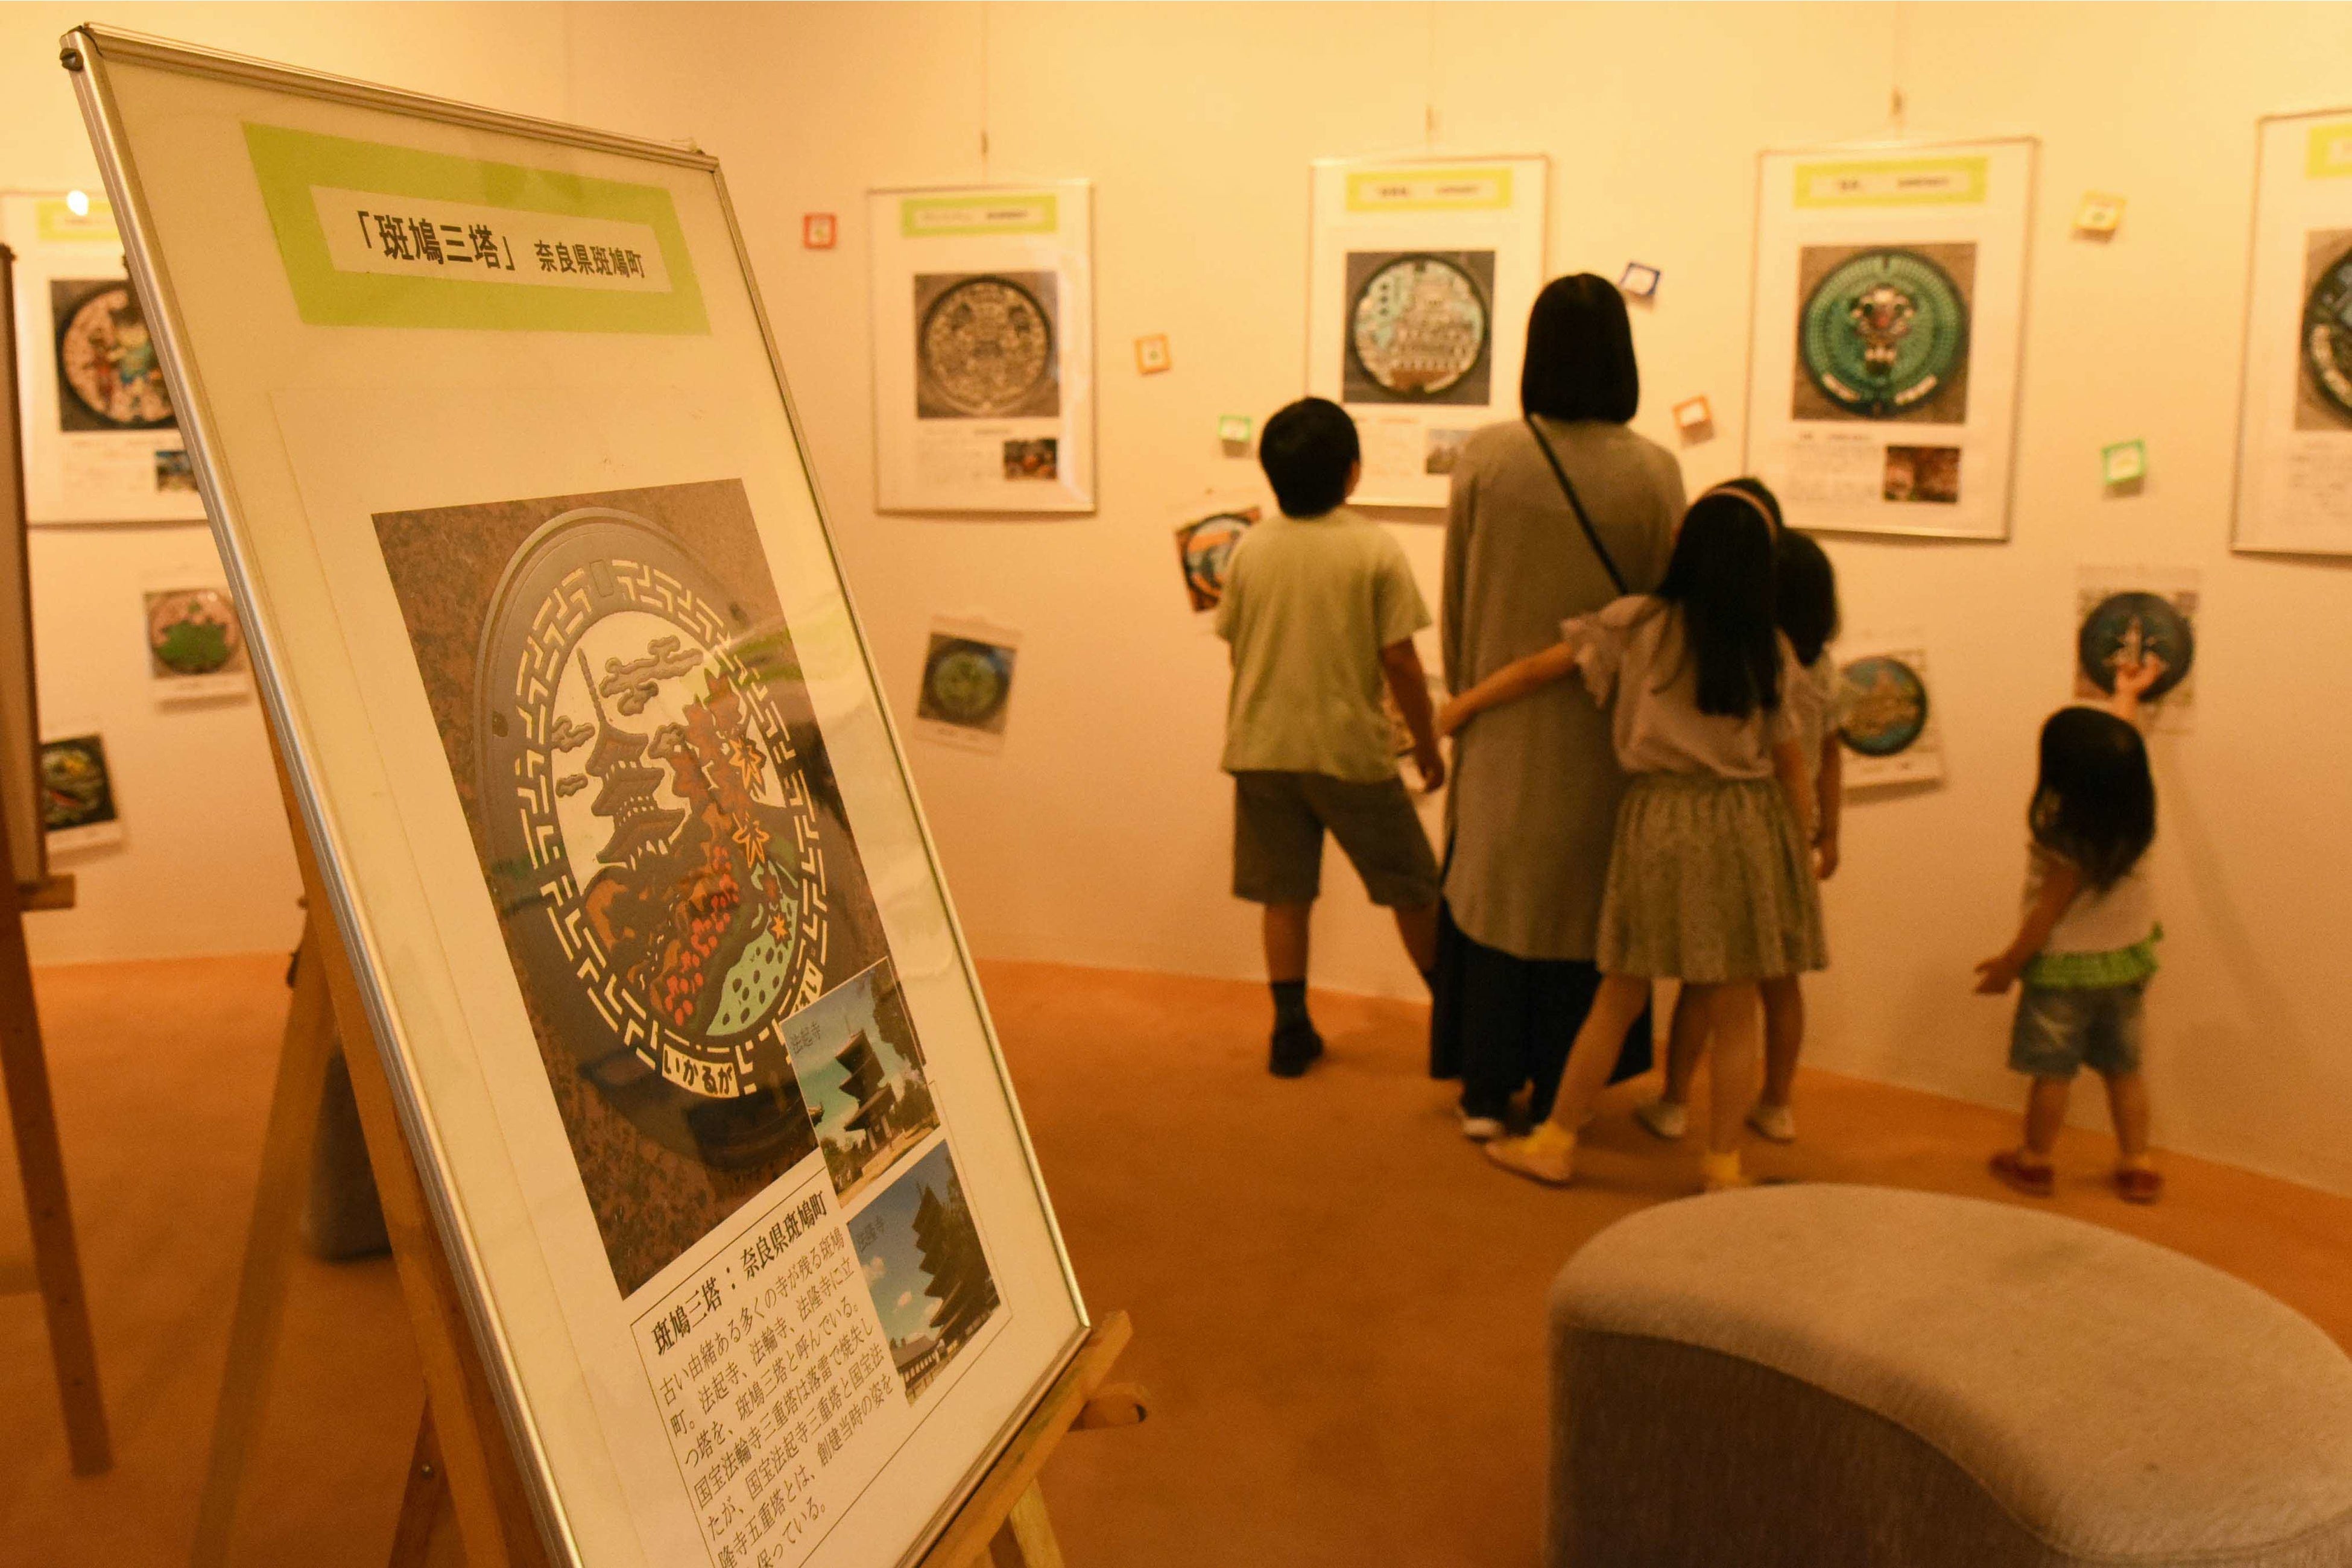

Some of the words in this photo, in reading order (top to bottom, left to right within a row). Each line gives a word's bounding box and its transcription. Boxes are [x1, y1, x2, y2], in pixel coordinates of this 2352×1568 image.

[357, 210, 515, 270] 「斑鳩三塔」
[534, 239, 645, 278] 奈良県斑鳩町
[664, 1049, 733, 1095] いかるが
[660, 1226, 844, 1406] 古い由緒ある多くの寺が残る斑鳩
[671, 1257, 854, 1438] 町。法起寺、法輪寺、法隆寺に立
[685, 1296, 858, 1468] つ塔を、斑鳩三塔と呼んでいる。
[694, 1318, 873, 1510] 国宝法輪寺三重塔は落雷で焼失し
[707, 1342, 884, 1541] たが、国宝法起寺三重塔と国宝法
